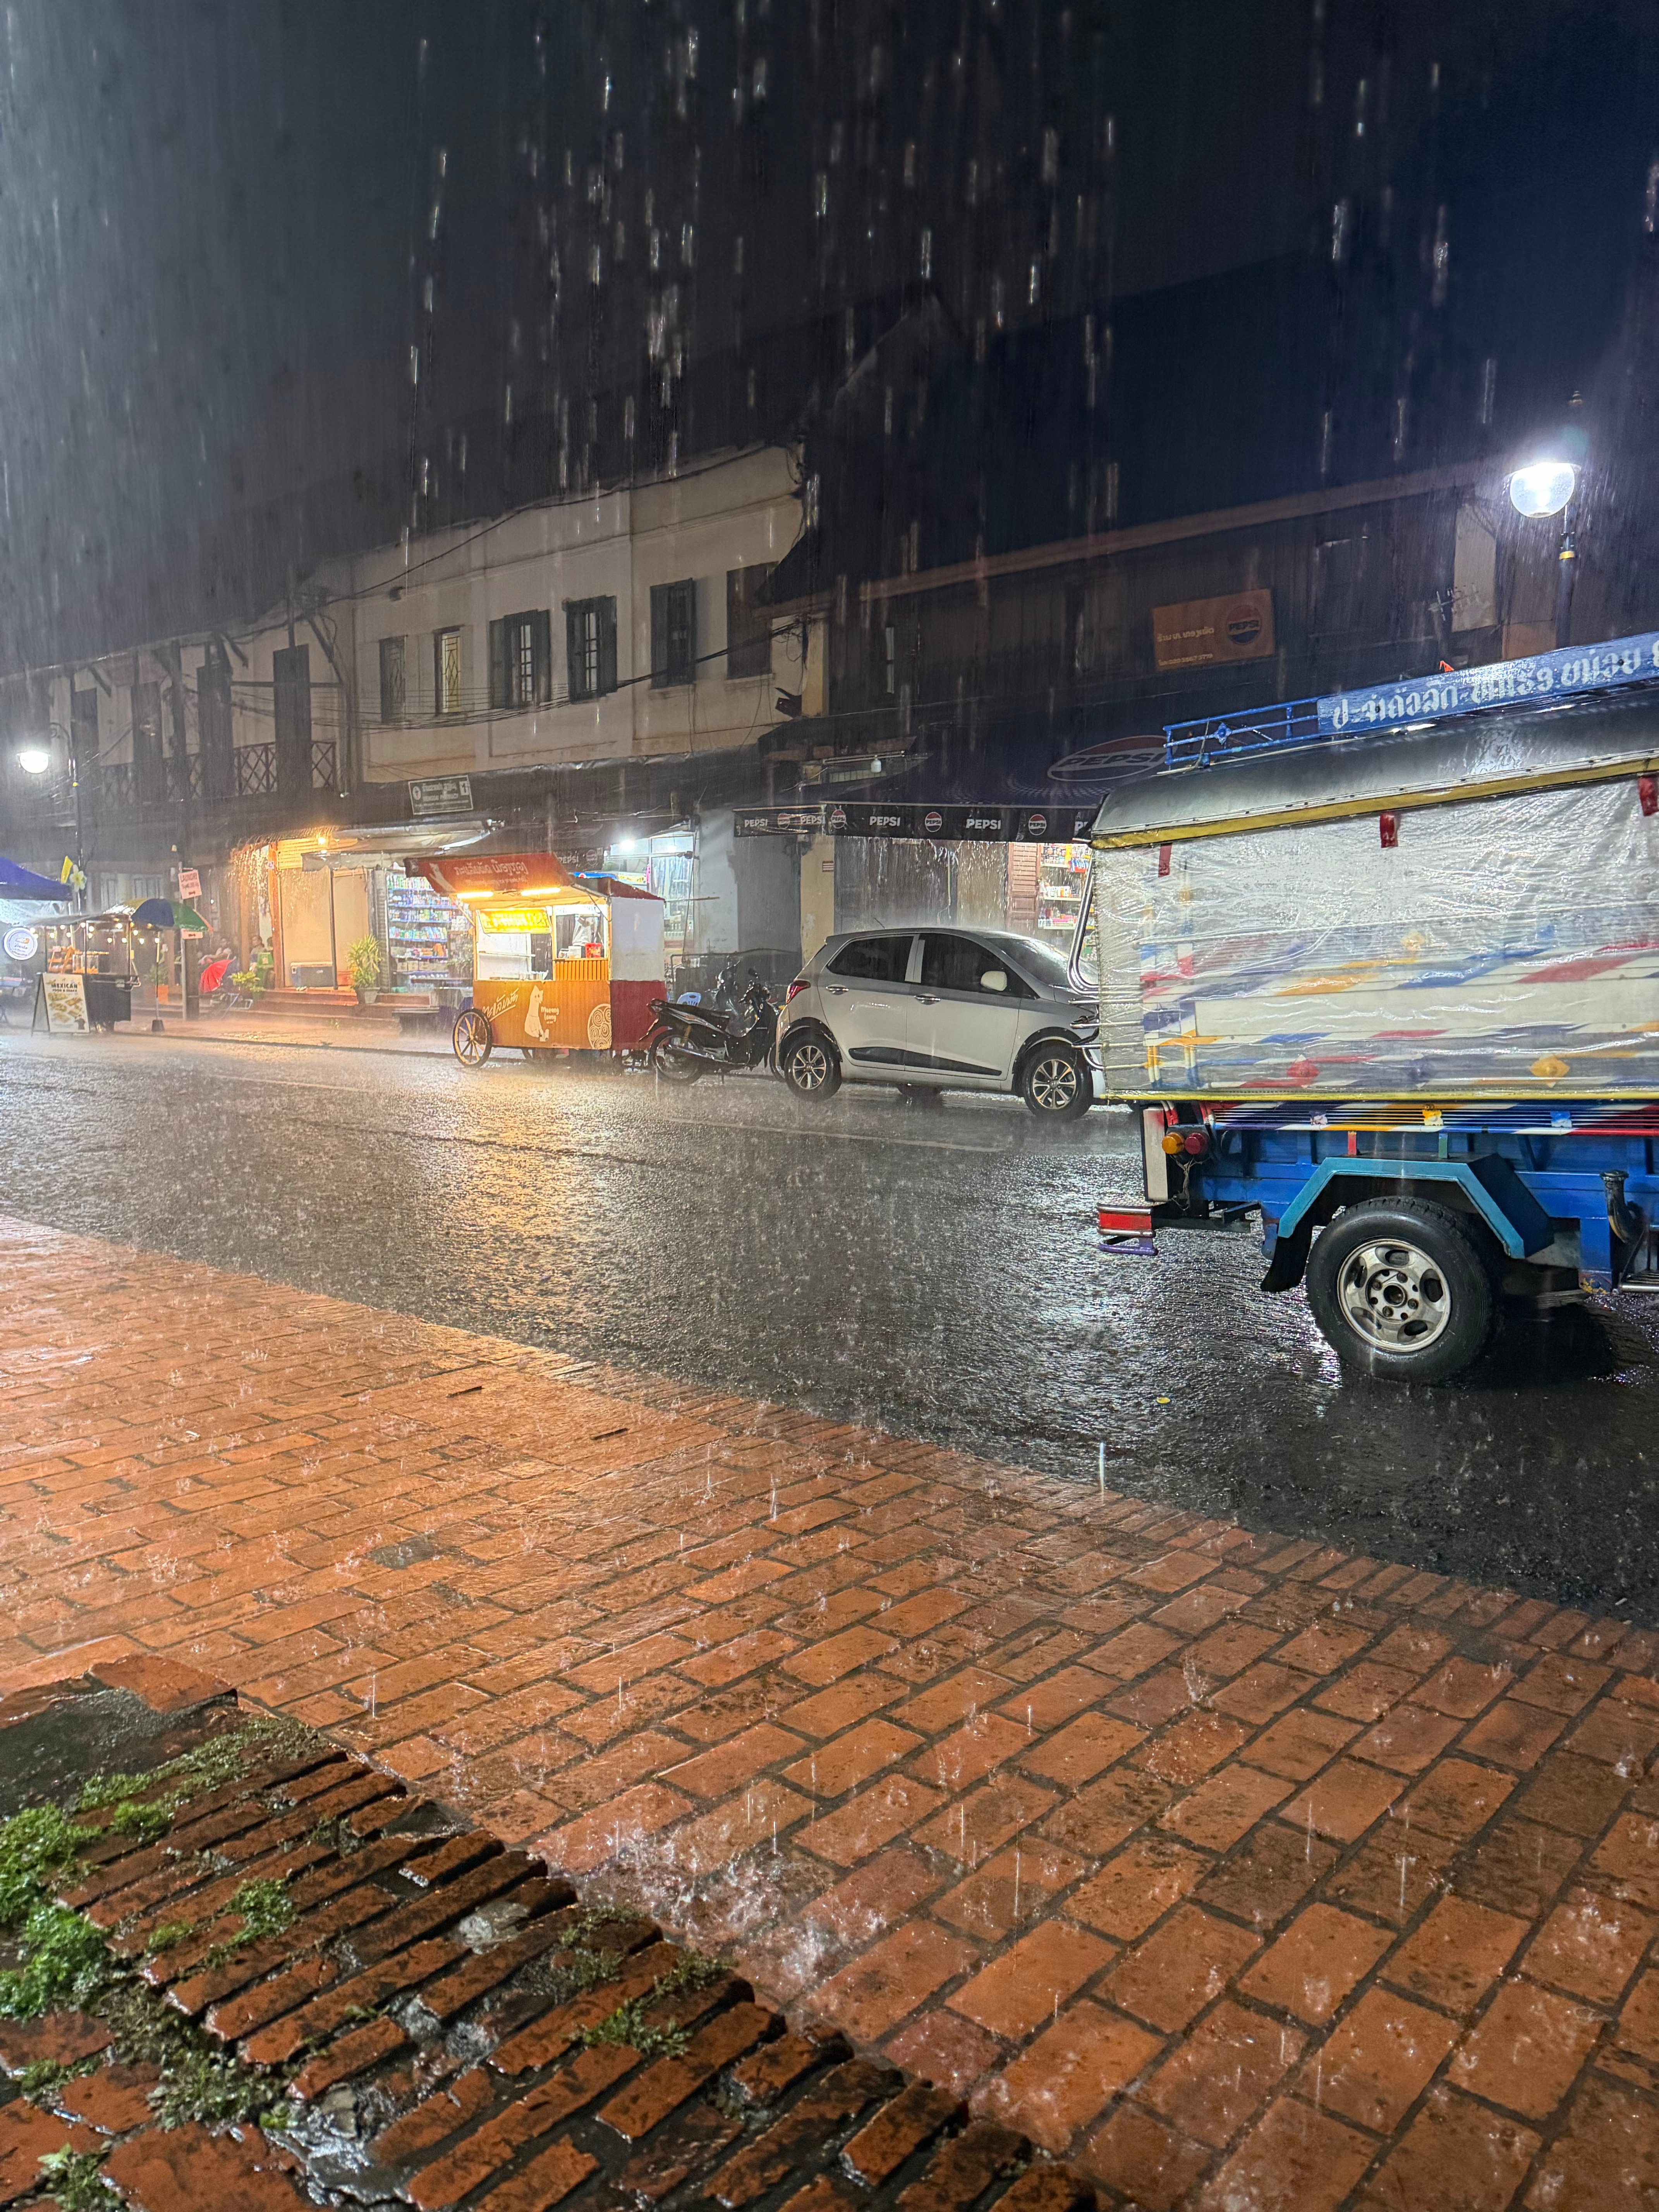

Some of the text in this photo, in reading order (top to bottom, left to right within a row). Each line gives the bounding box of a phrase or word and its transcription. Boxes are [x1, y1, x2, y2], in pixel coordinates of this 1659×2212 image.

[1058, 752, 1167, 767] PEPSI
[745, 819, 768, 828] PEPSI
[869, 816, 901, 826] PEPSI
[966, 819, 1001, 830] PEPSI
